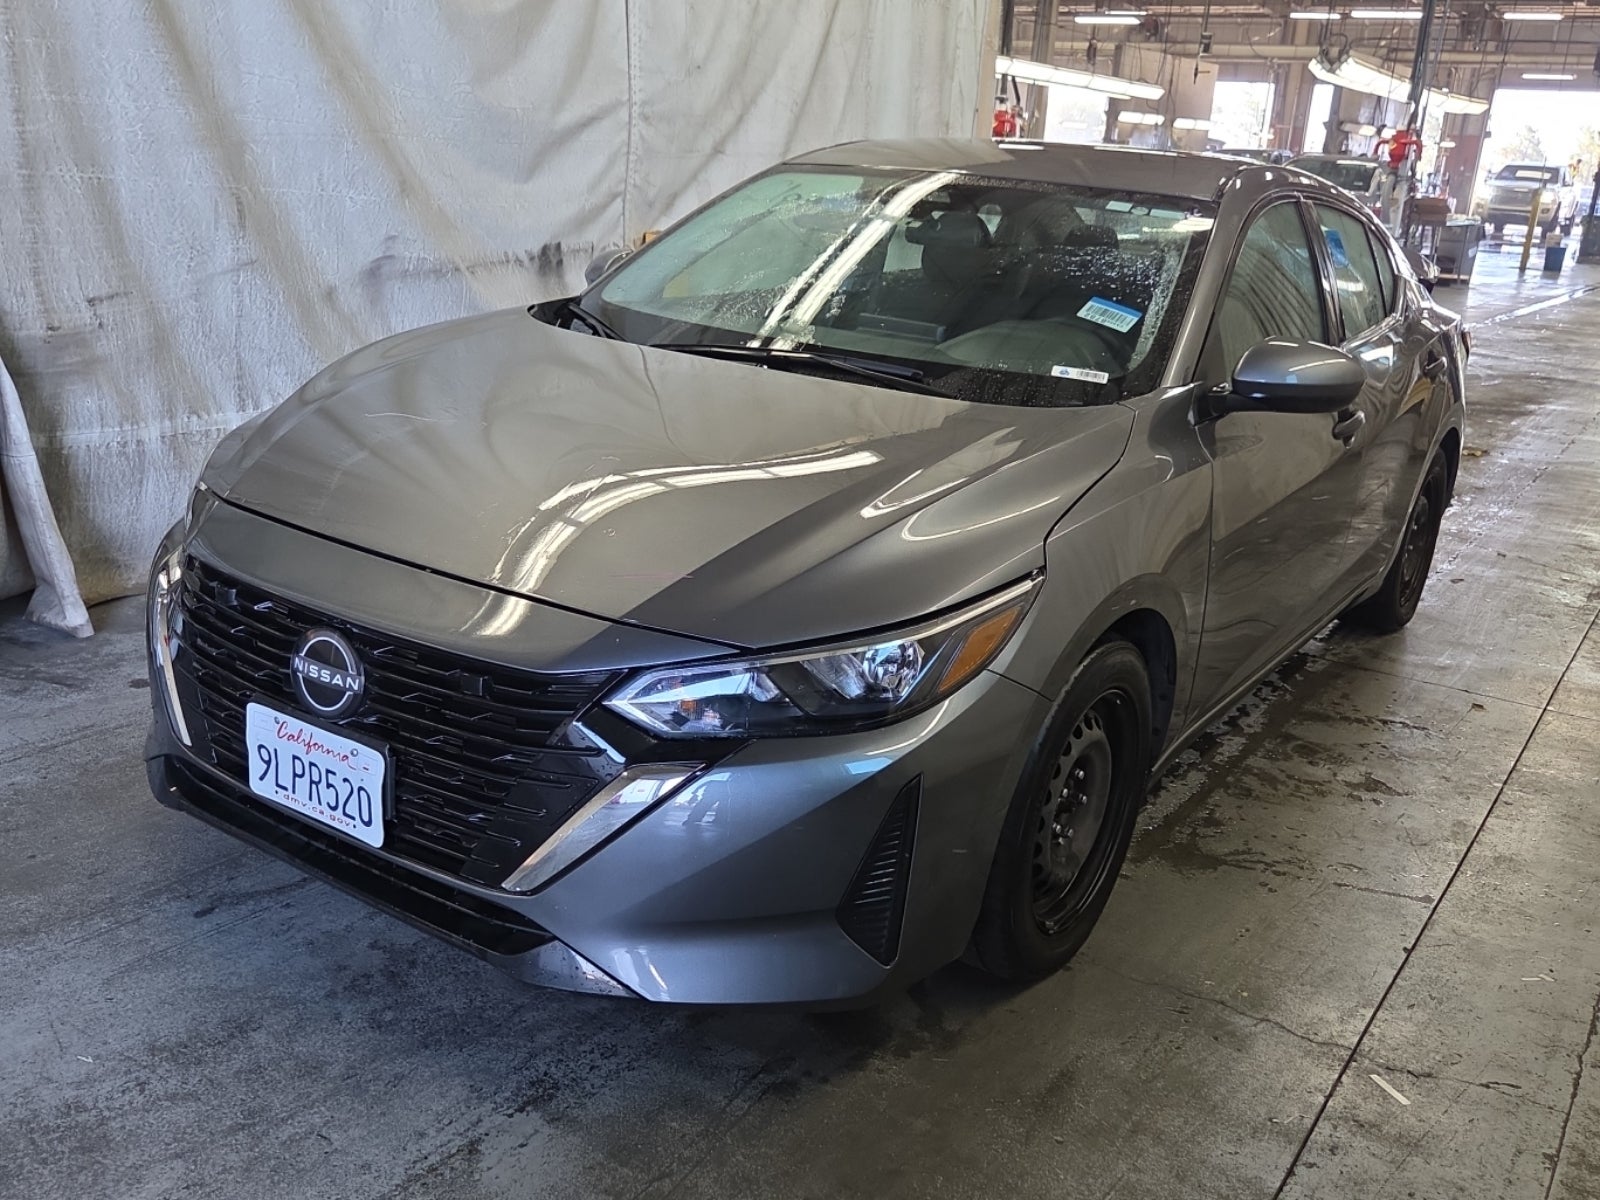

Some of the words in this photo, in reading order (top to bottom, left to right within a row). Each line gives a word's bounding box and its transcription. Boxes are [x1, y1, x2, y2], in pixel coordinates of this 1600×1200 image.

[294, 657, 360, 691] NISSAN
[276, 720, 357, 770] California
[257, 743, 373, 828] 9LPR520
[283, 793, 351, 828] dmv.ca.gov
